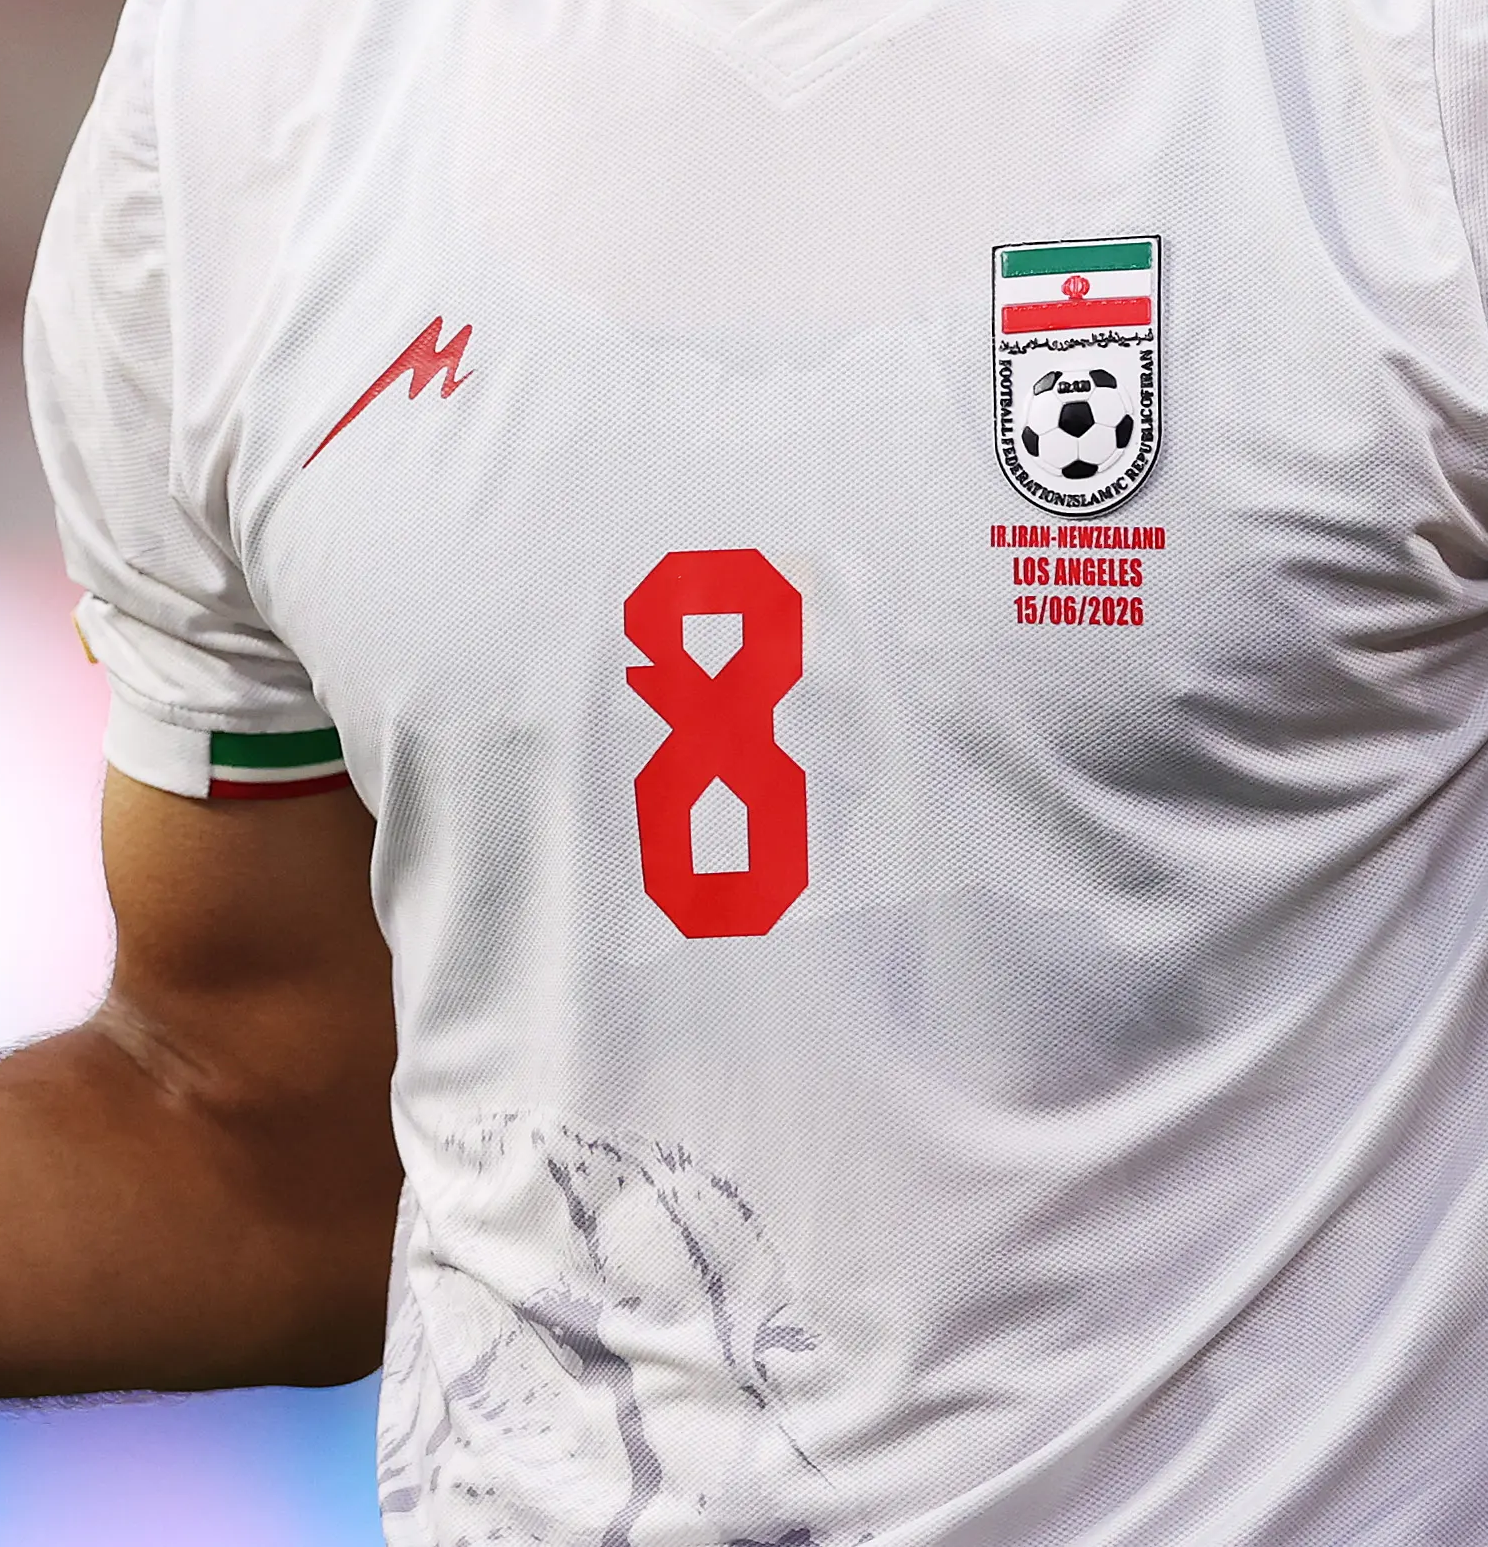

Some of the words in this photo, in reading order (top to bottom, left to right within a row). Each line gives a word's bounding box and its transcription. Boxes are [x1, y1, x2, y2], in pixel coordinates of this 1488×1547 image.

[1140, 349, 1154, 389] IRAN
[999, 359, 1013, 437] FOOTBALL
[1140, 389, 1154, 408] OF
[1125, 408, 1154, 482] REPUBLIC
[1001, 438, 1066, 507] FEDERATION
[1066, 477, 1129, 508] ISLAMIC
[1013, 556, 1050, 586] LOS
[1054, 557, 1143, 587] ANGELES
[1013, 595, 1144, 626] 15/06/2026
[623, 548, 809, 940] 8
